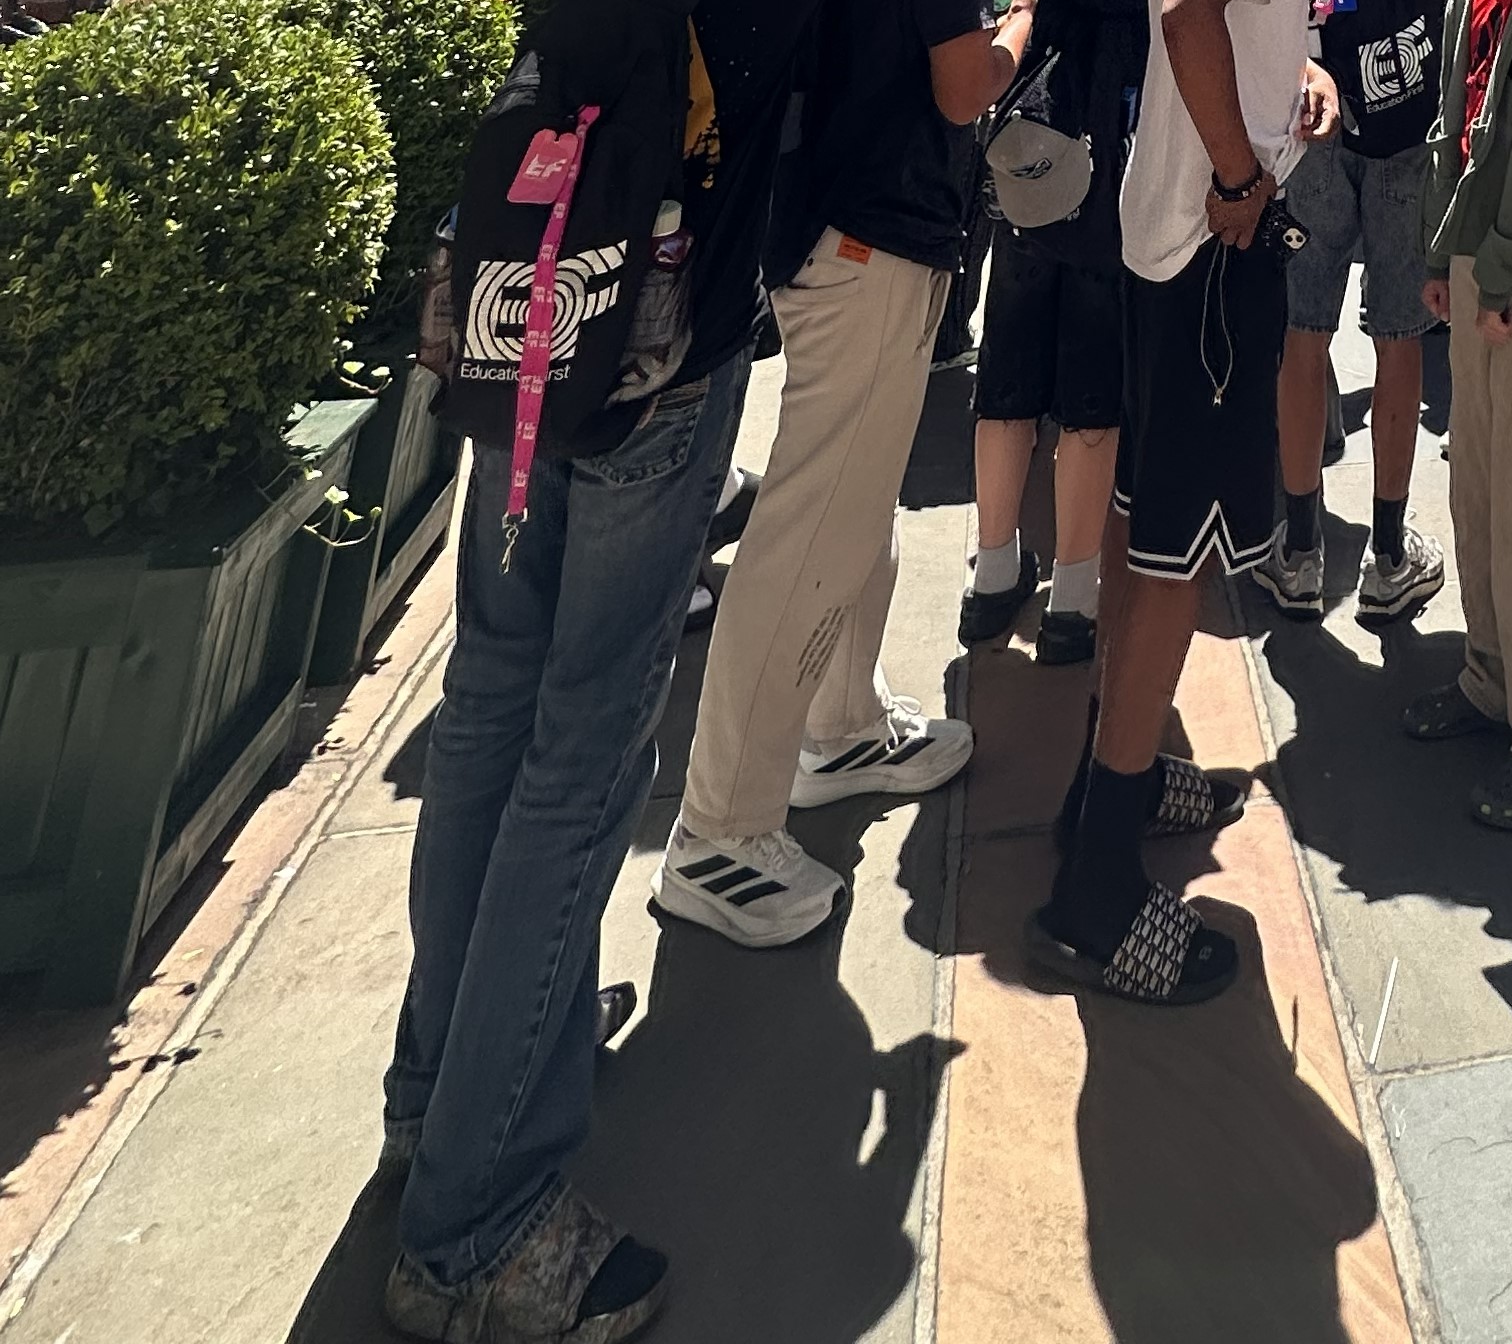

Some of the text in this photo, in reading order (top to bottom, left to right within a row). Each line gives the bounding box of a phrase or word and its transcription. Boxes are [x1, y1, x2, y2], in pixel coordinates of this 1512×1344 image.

[1358, 14, 1434, 104] EF
[524, 153, 568, 179] EF
[463, 238, 628, 360] EF
